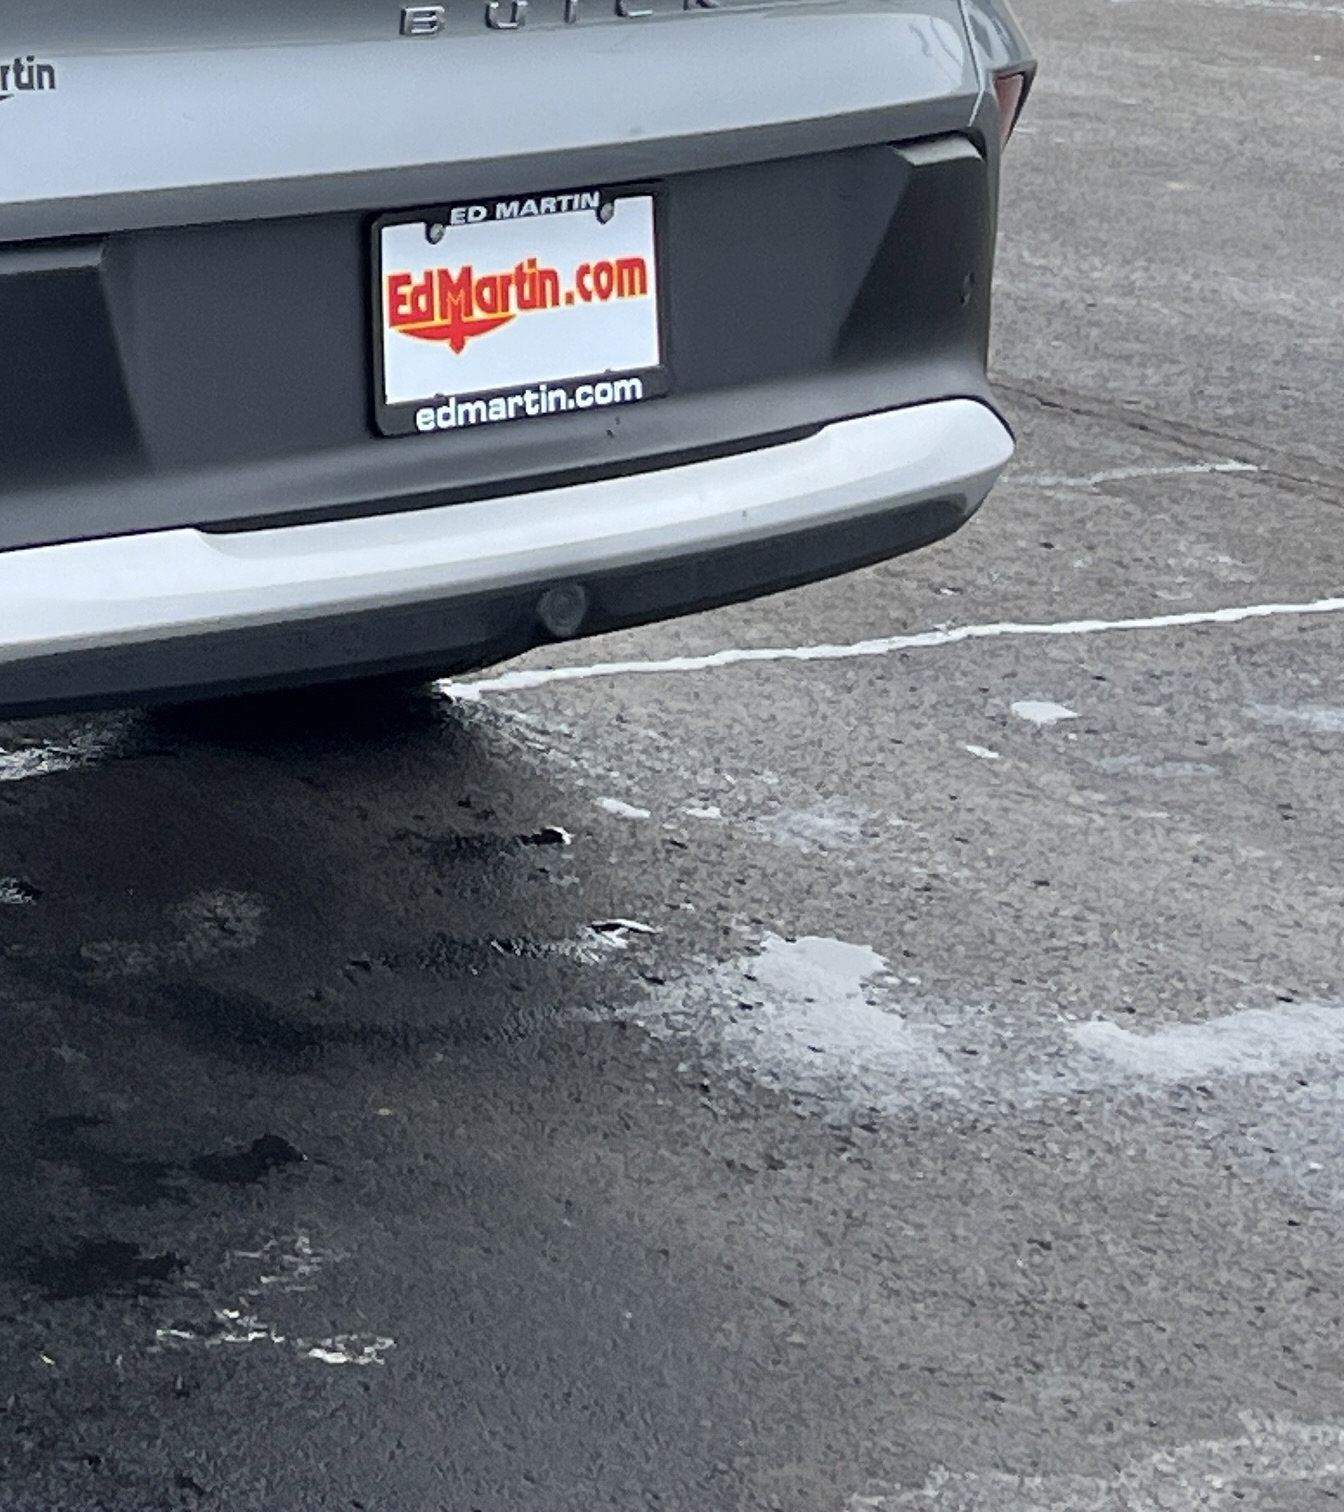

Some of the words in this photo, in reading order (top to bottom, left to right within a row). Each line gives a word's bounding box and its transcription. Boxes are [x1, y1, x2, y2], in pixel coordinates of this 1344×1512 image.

[450, 206, 486, 226] ED
[495, 190, 601, 220] MARTIN
[387, 256, 648, 330] EdMartin.com
[416, 376, 643, 433] edmartin.com
